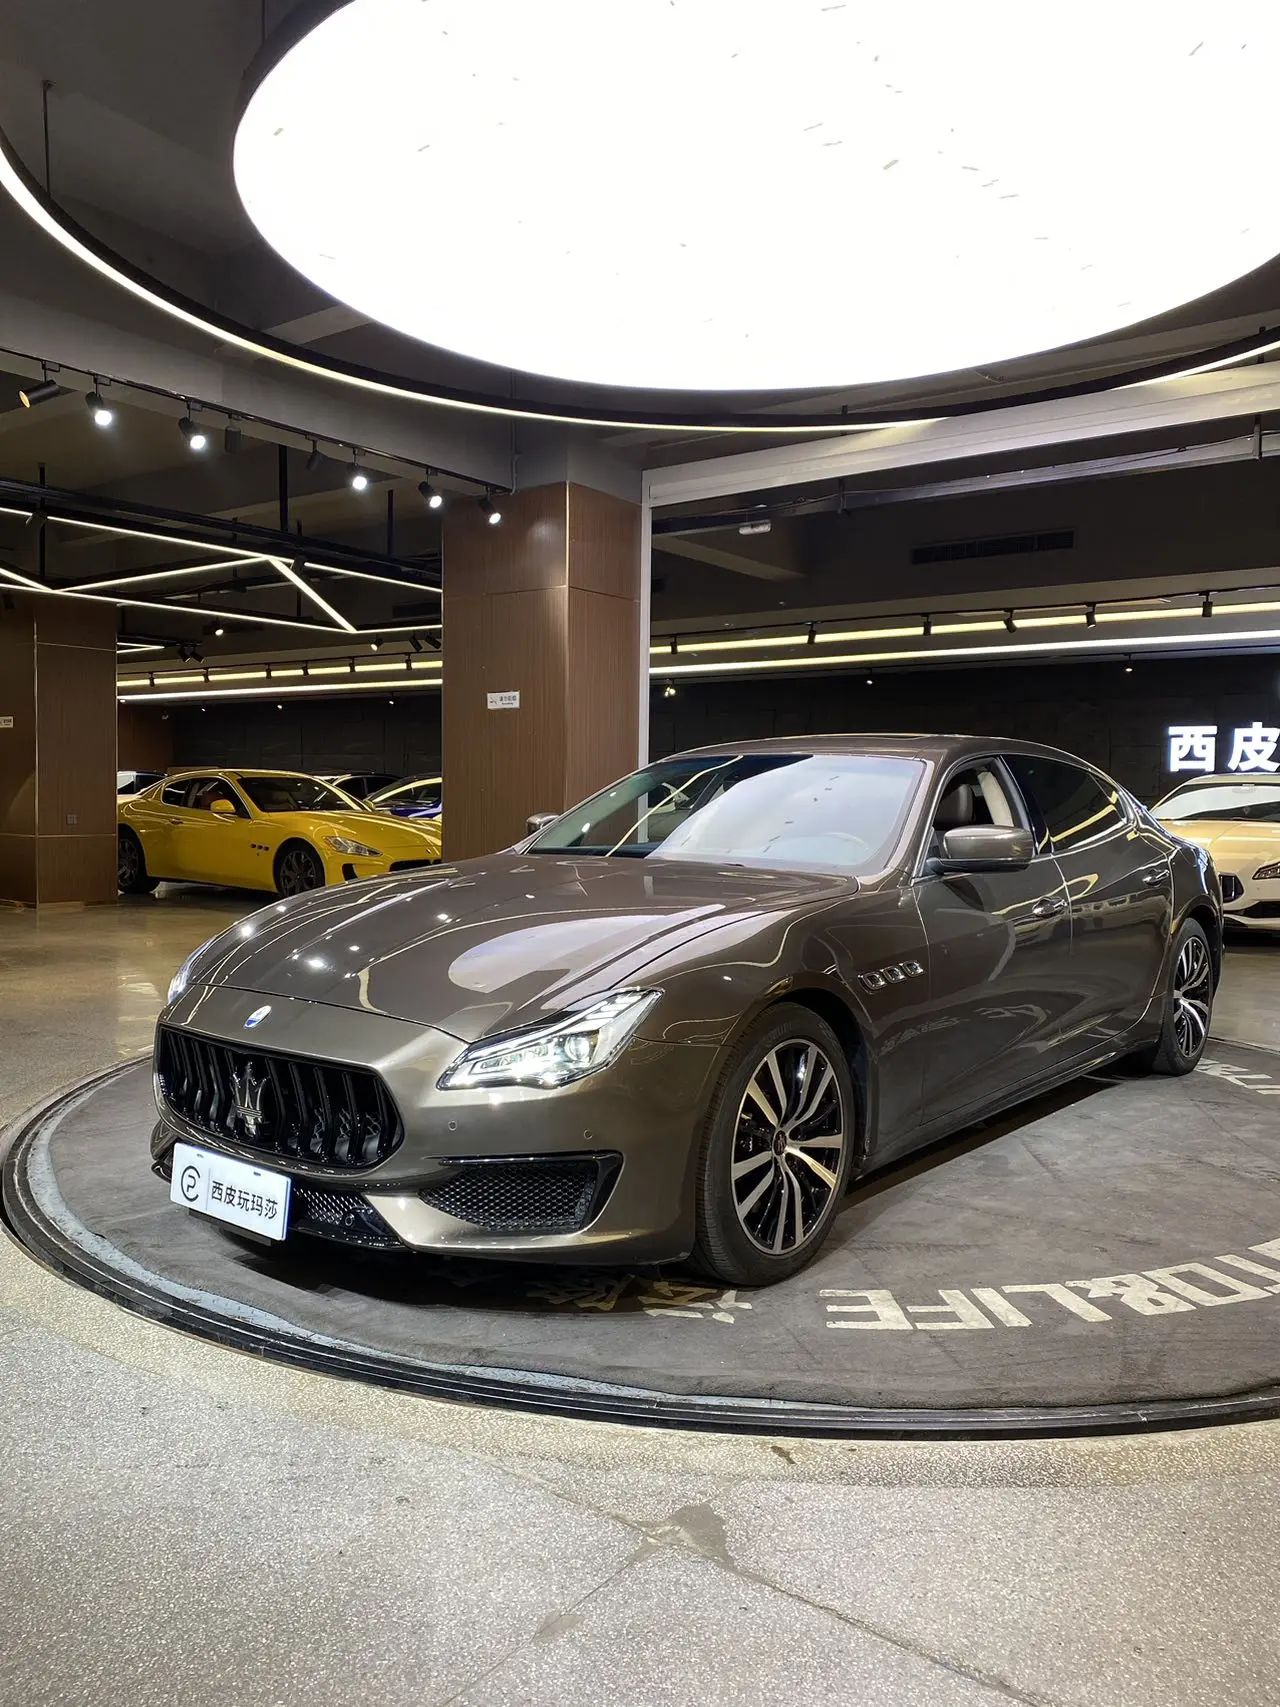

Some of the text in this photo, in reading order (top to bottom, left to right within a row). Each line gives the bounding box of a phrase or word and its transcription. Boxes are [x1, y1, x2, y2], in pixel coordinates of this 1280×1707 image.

[1167, 721, 1280, 773] 西皮
[212, 1180, 278, 1220] 西皮玩玛莎
